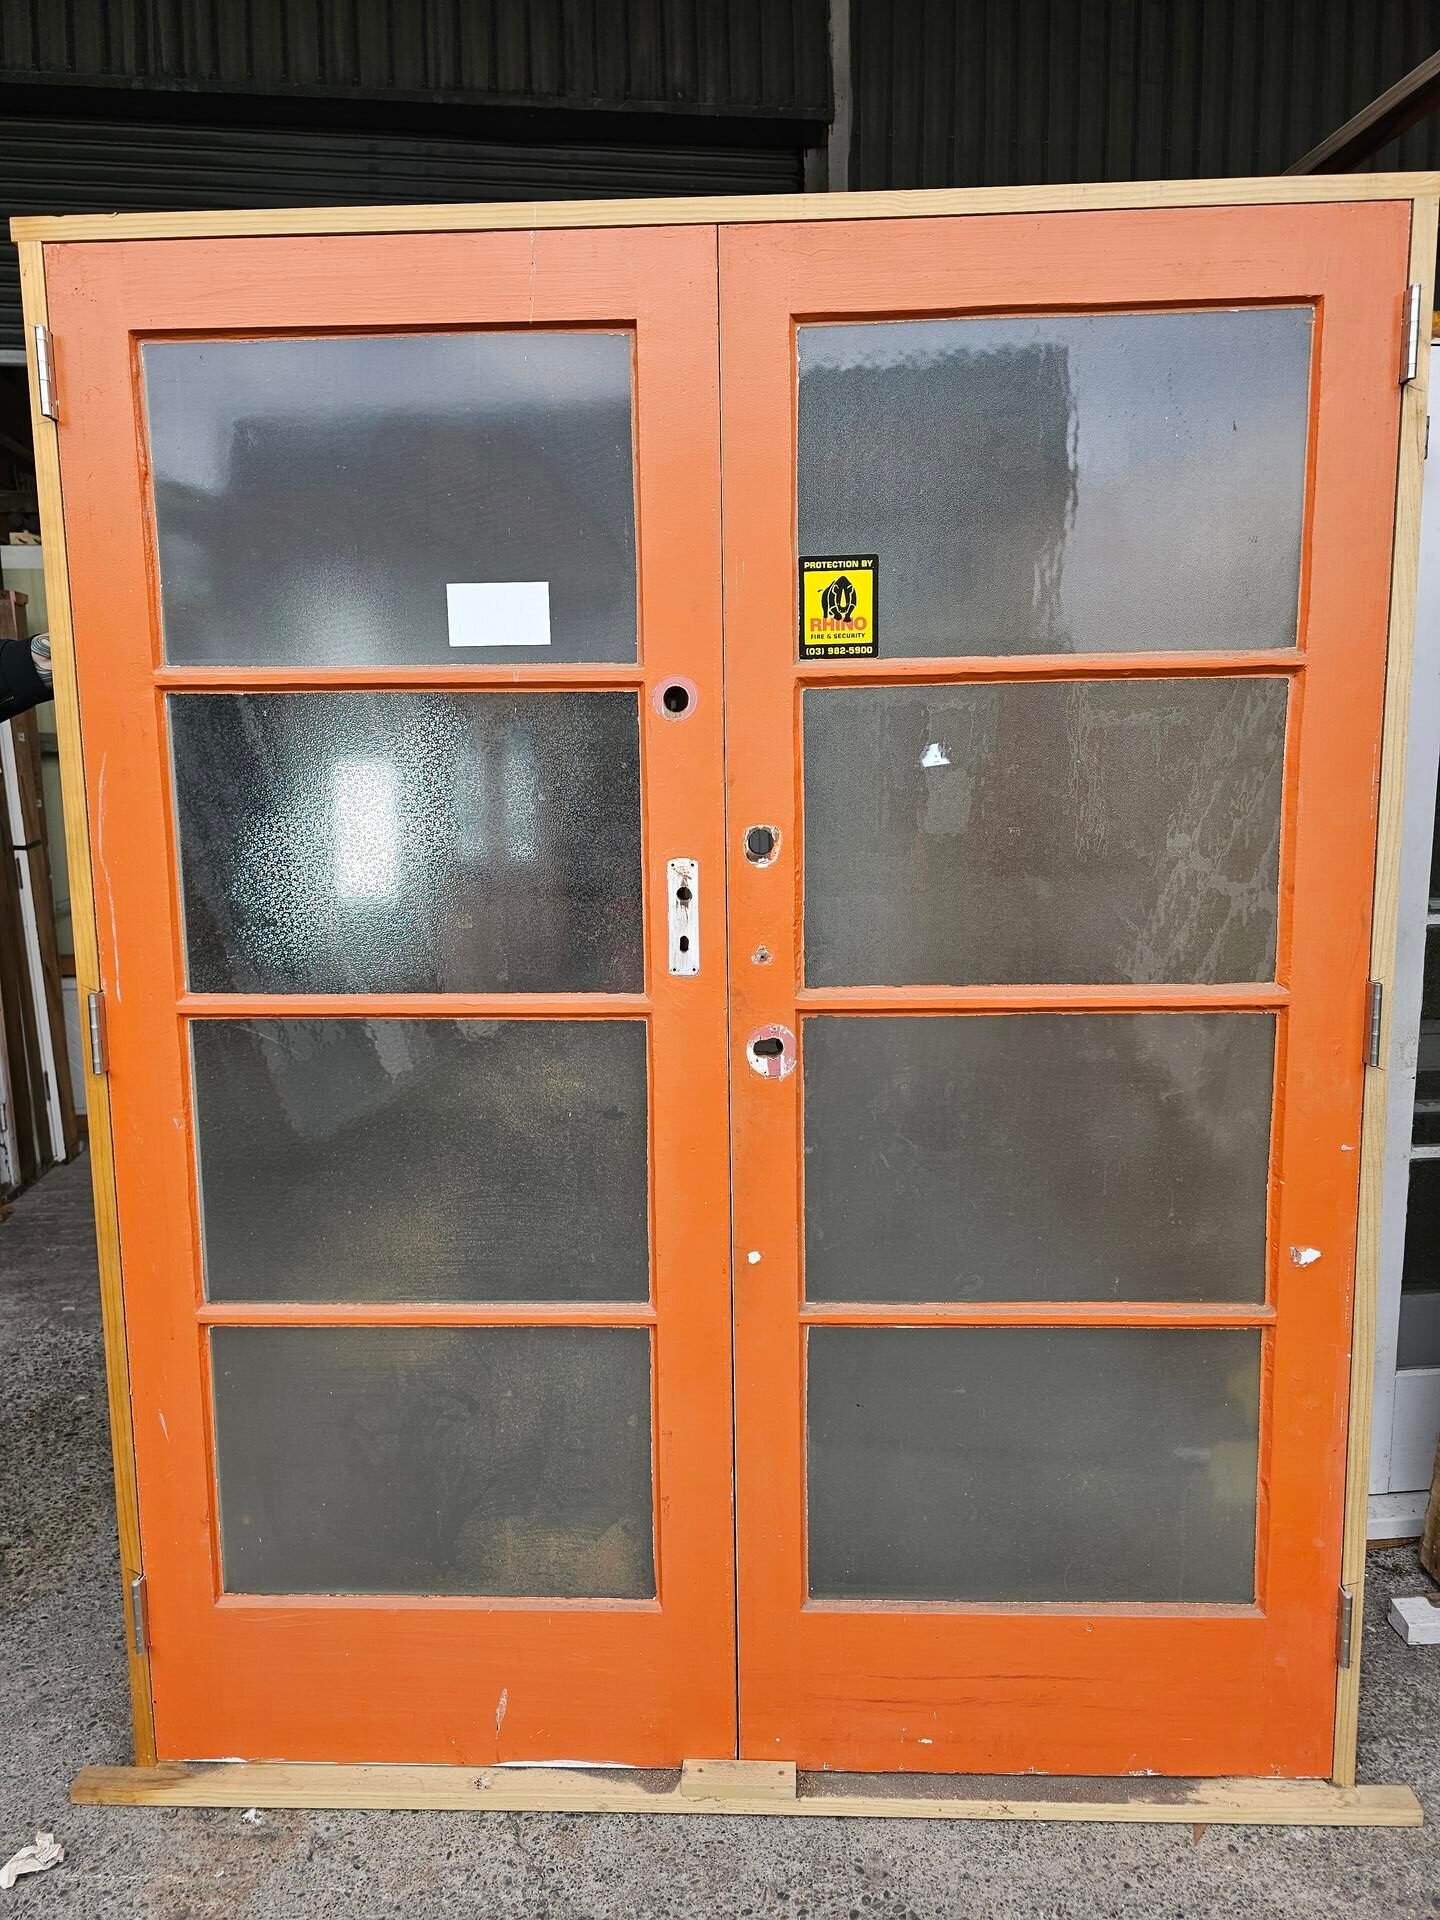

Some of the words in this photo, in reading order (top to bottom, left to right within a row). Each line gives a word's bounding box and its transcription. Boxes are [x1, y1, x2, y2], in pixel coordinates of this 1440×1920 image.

[804, 560, 859, 569] PROTECTION
[861, 559, 873, 568] BY
[810, 617, 867, 631] RHINO
[806, 648, 825, 656] (03)
[828, 646, 873, 655] 982-5900
